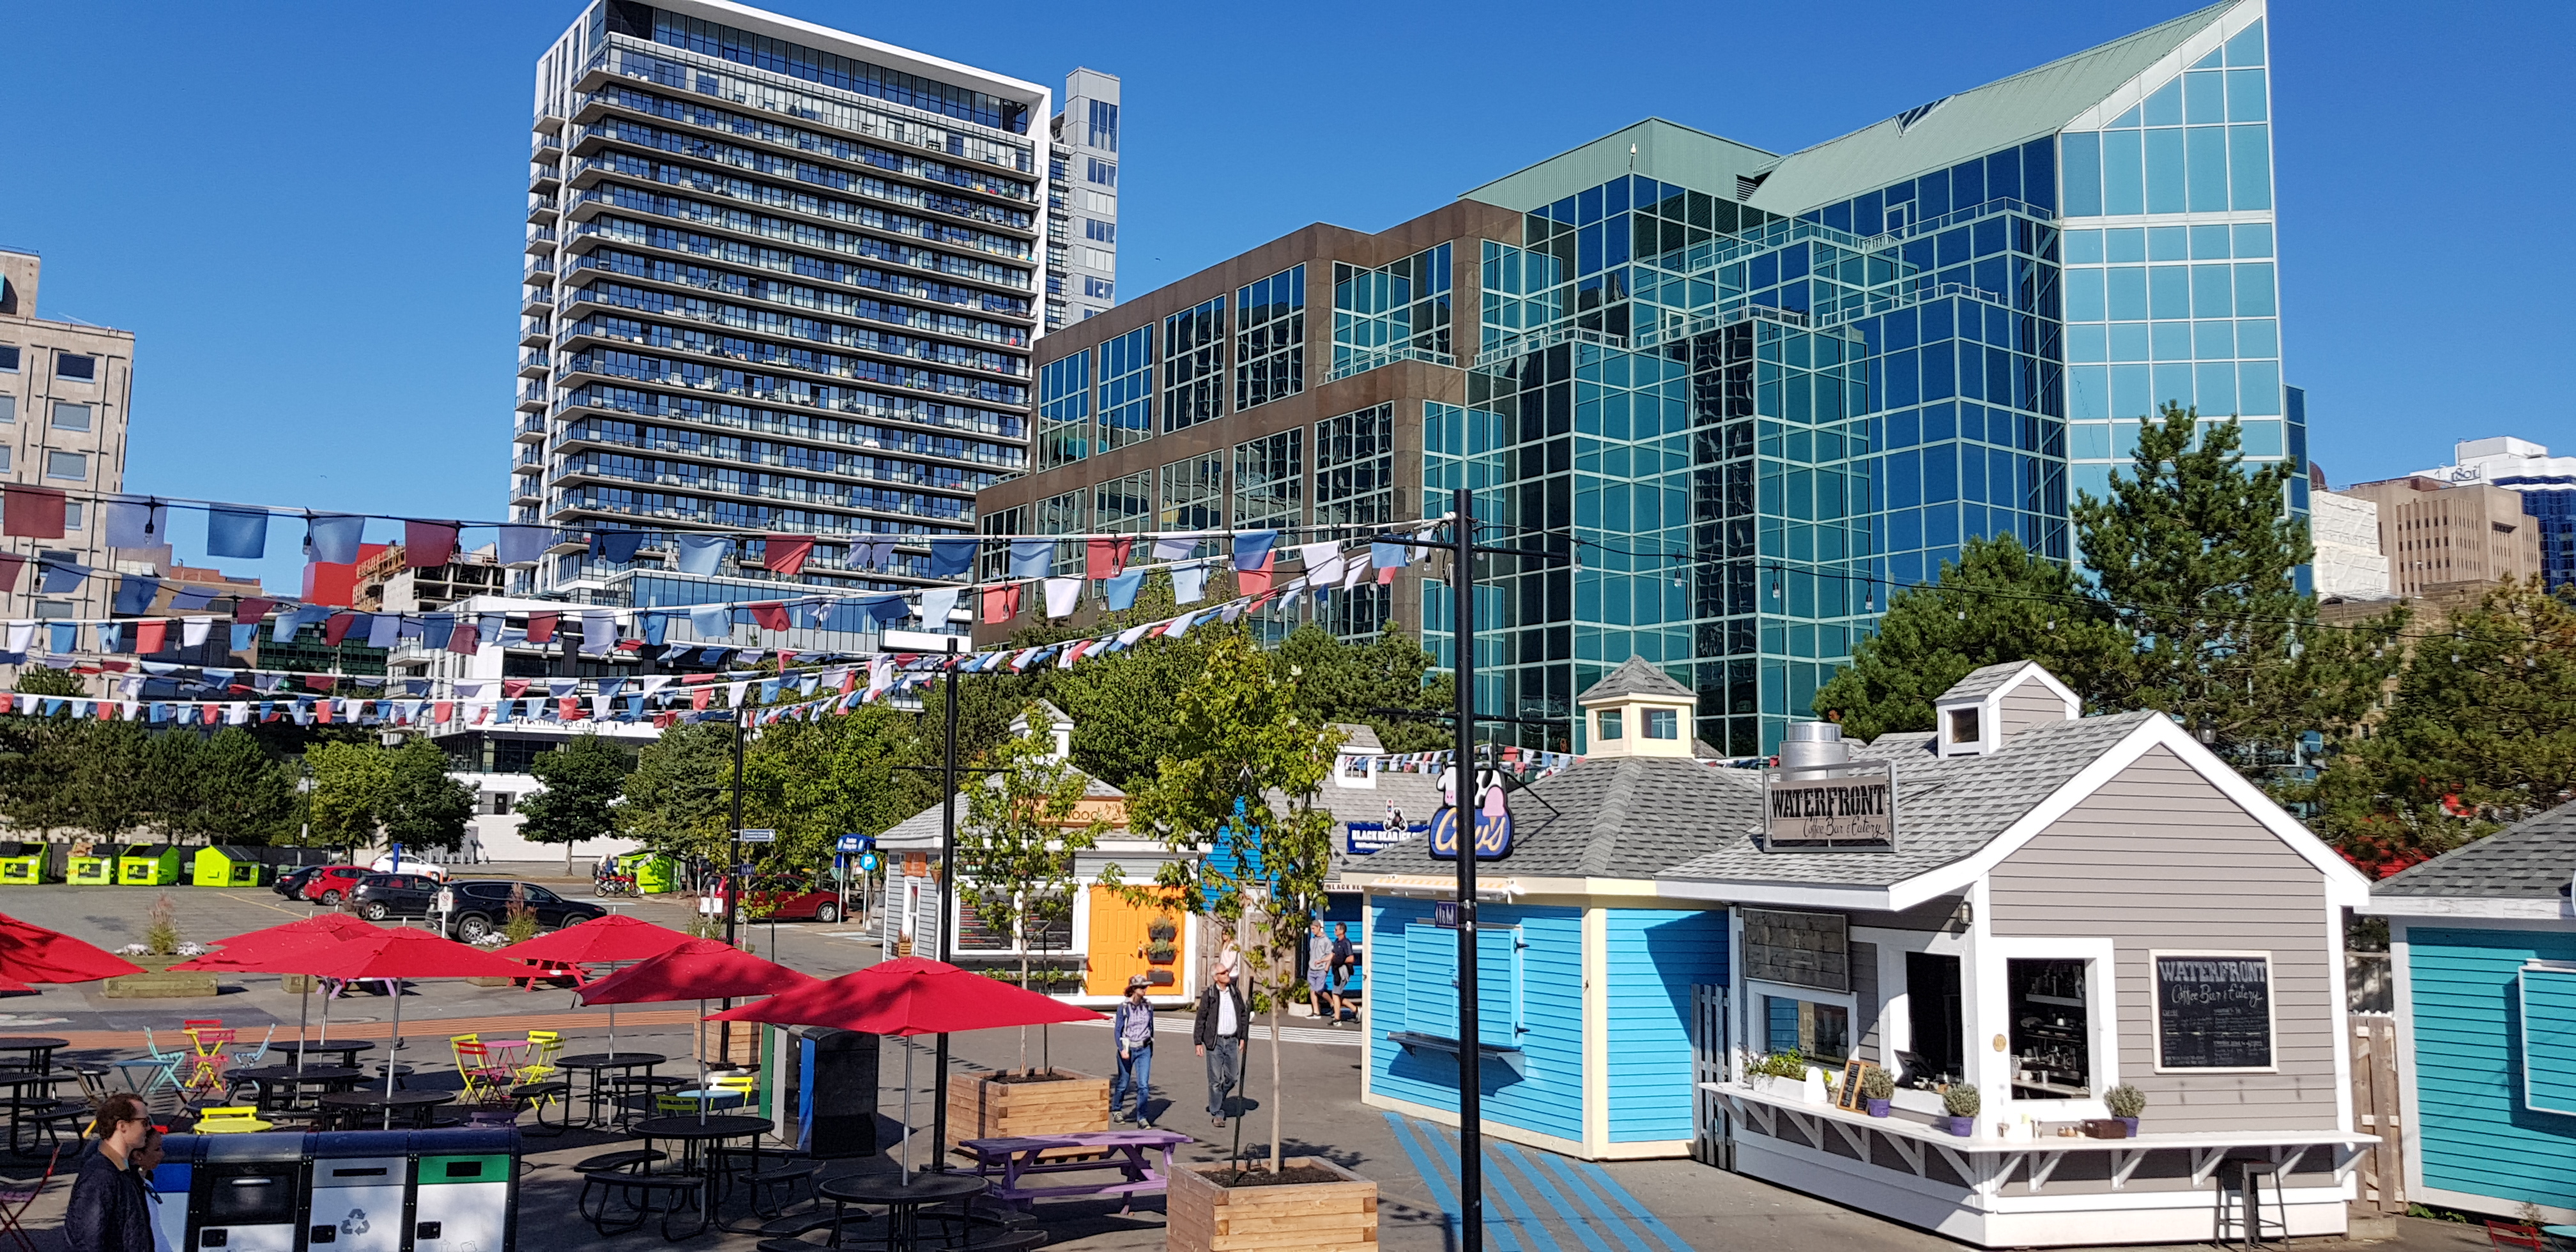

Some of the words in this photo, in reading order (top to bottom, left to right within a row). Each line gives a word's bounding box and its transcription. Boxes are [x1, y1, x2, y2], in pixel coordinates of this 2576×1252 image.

[1770, 784, 1885, 818] WATERFRONT
[1351, 830, 1377, 841] BLACK
[1377, 831, 1399, 842] BEAR
[1804, 816, 1823, 838] Coffee
[1824, 816, 1843, 836] Bar
[1851, 816, 1885, 839] Eatery
[864, 856, 873, 868] P
[2158, 961, 2266, 982] WATERFRONT
[2172, 984, 2198, 1005] Coffee
[2200, 983, 2221, 1004] Bar
[2228, 983, 2263, 1008] Eatery
